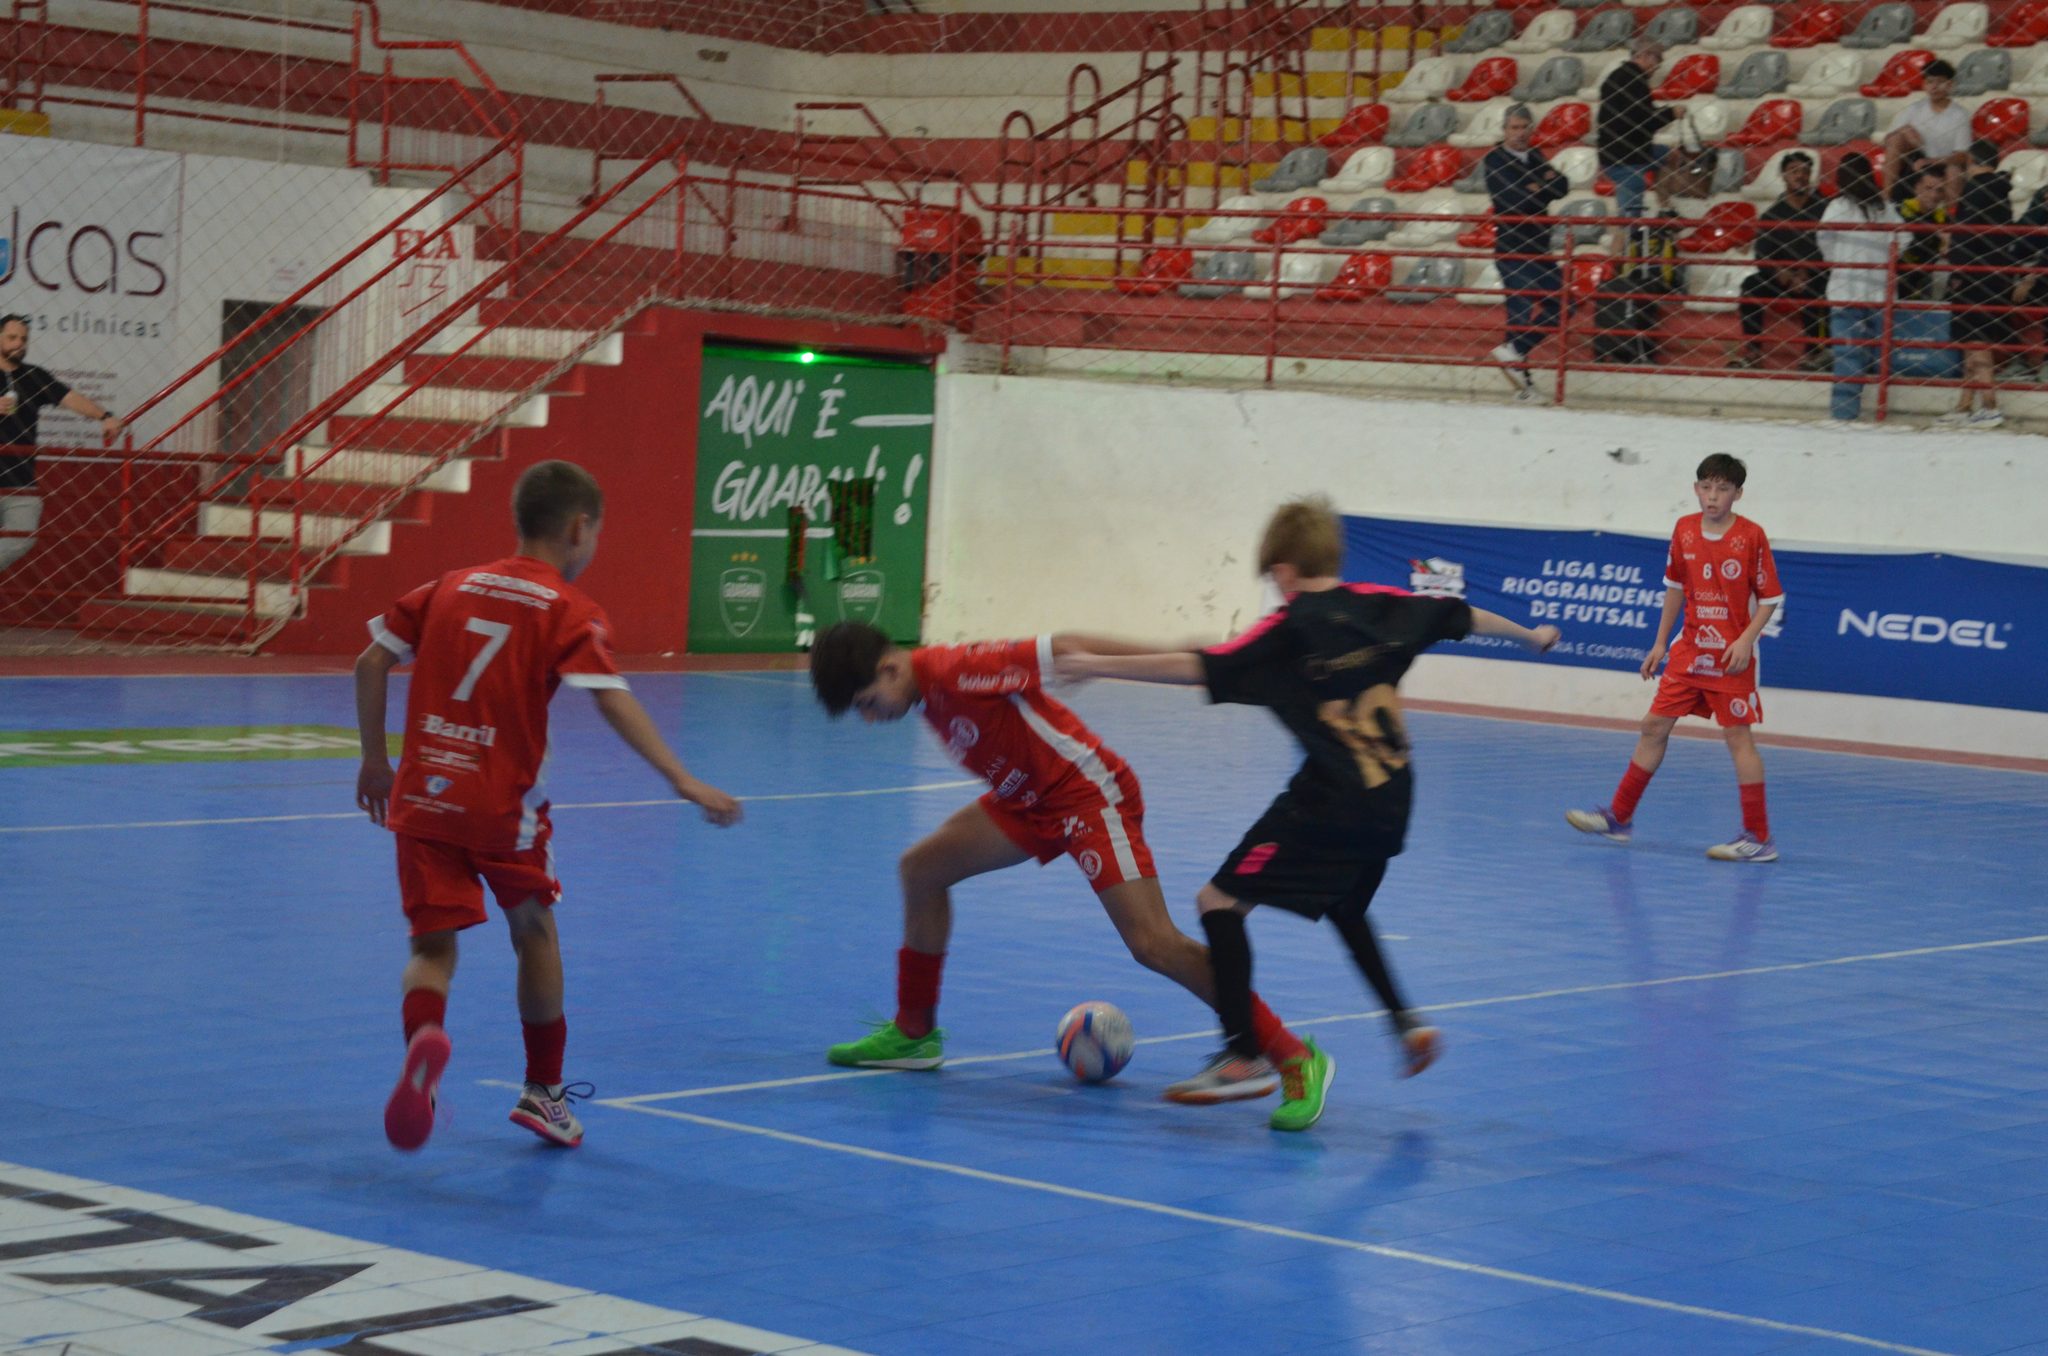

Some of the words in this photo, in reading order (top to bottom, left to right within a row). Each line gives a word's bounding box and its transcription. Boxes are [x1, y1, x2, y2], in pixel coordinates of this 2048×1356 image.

[813, 372, 847, 438] É
[1541, 559, 1596, 580] LIGA
[1599, 564, 1643, 584] SUL
[1703, 563, 1712, 580] 6
[1501, 576, 1666, 609] RIOGRANDENS
[1529, 599, 1561, 619] DE
[1562, 602, 1649, 629] FUTSAL
[1837, 608, 2008, 650] NEDEL
[452, 617, 512, 701] 7
